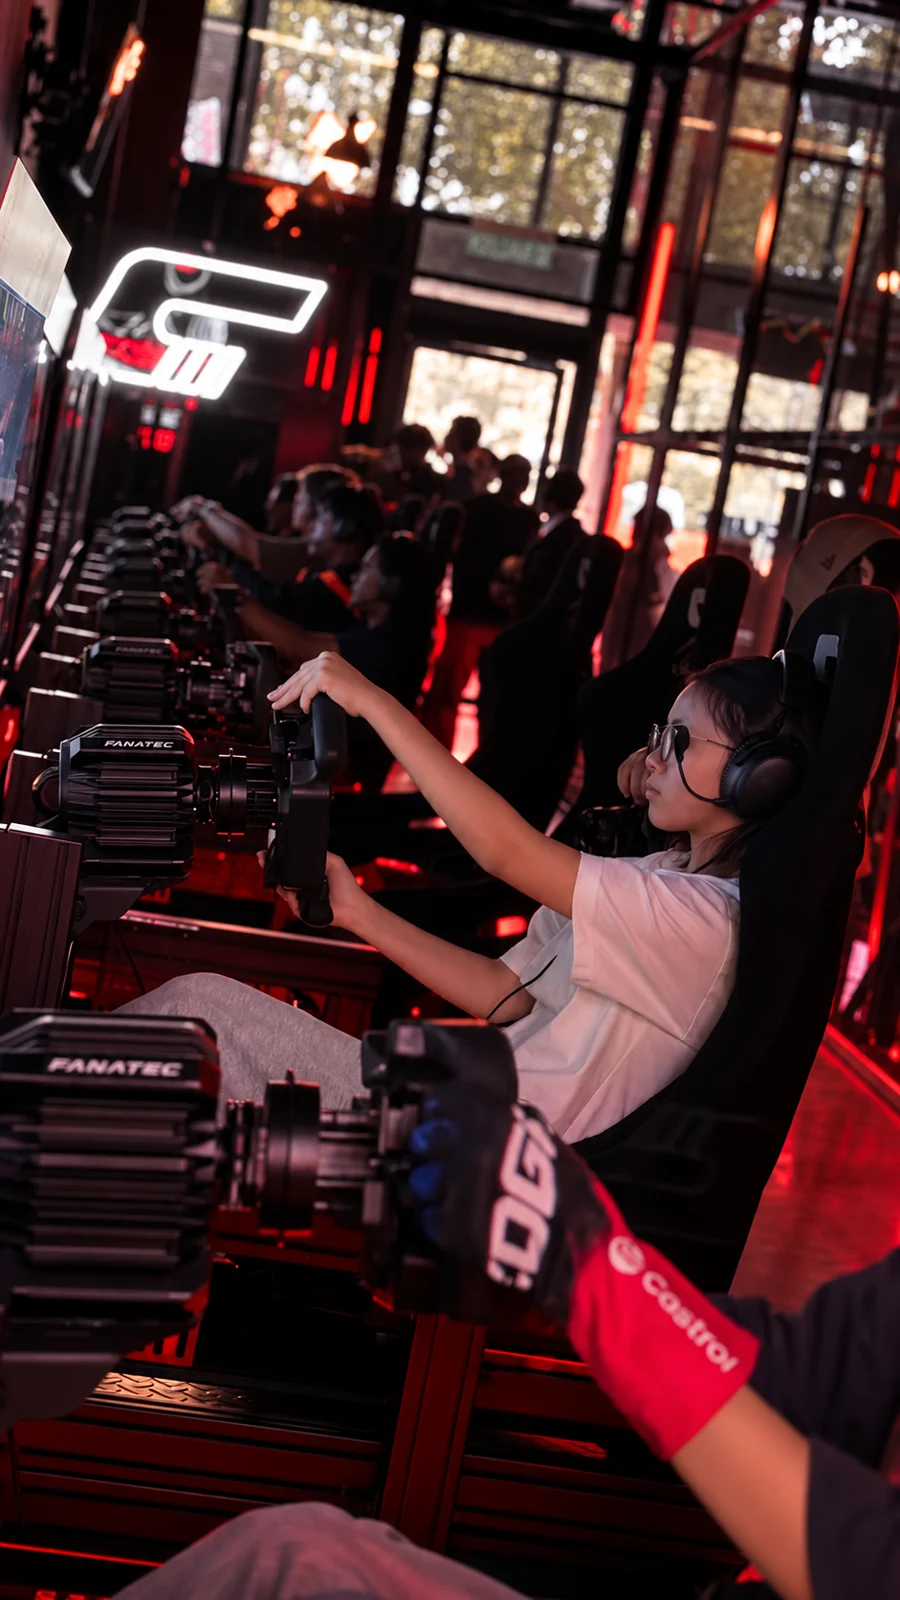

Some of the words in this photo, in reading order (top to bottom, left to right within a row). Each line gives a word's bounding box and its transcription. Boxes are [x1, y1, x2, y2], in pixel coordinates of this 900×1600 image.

[104, 740, 174, 748] FANATEC
[47, 1057, 183, 1077] FANATEC
[642, 1270, 739, 1373] Castrol
